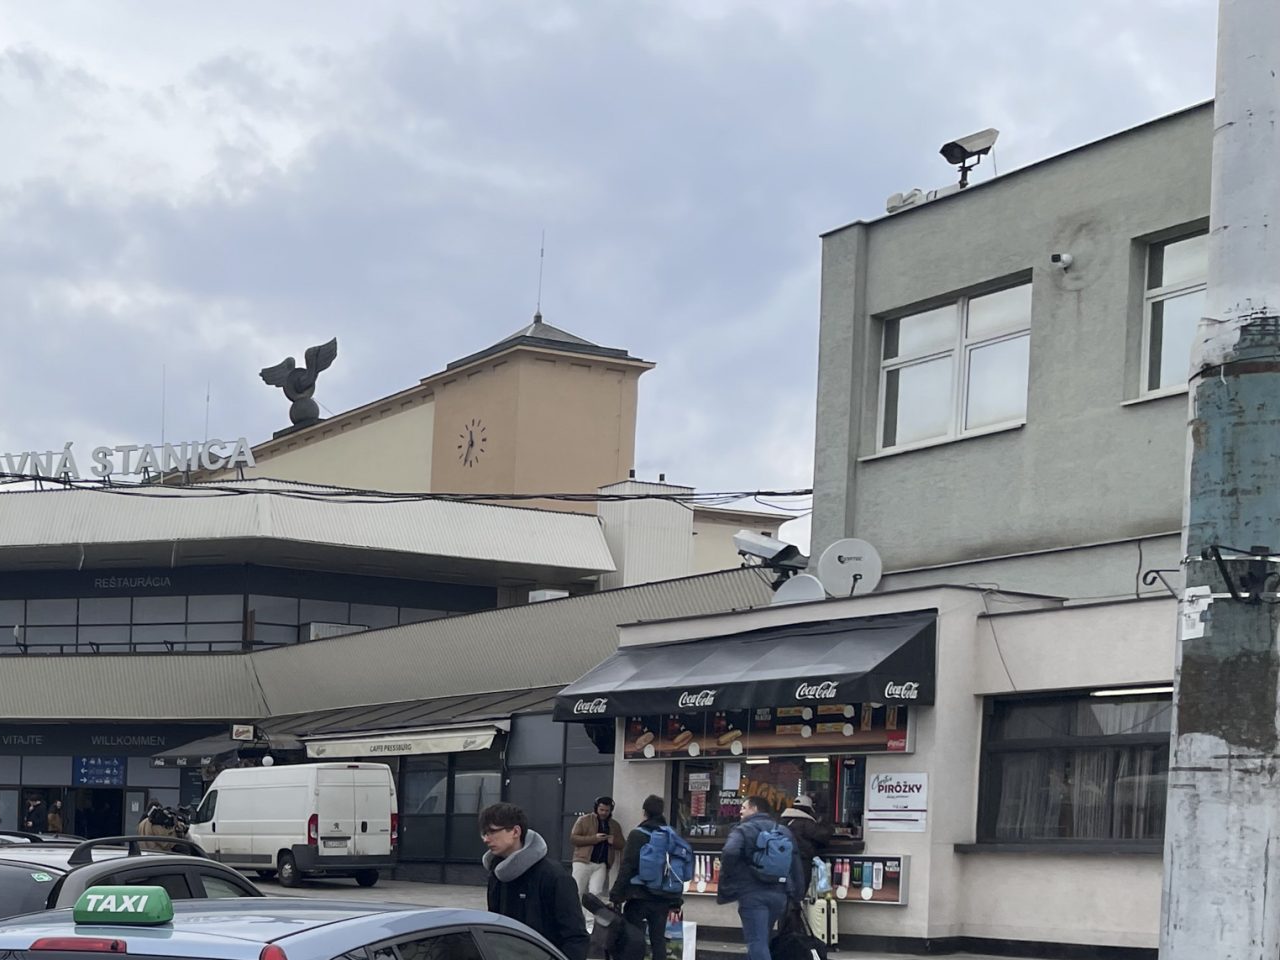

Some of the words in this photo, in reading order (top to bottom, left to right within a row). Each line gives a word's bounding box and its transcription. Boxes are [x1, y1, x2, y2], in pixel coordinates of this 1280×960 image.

[91, 437, 257, 477] STANICA
[2, 735, 43, 745] VITAJTE
[91, 735, 166, 746] WILLKOMMEN
[86, 894, 149, 913] TAXI
